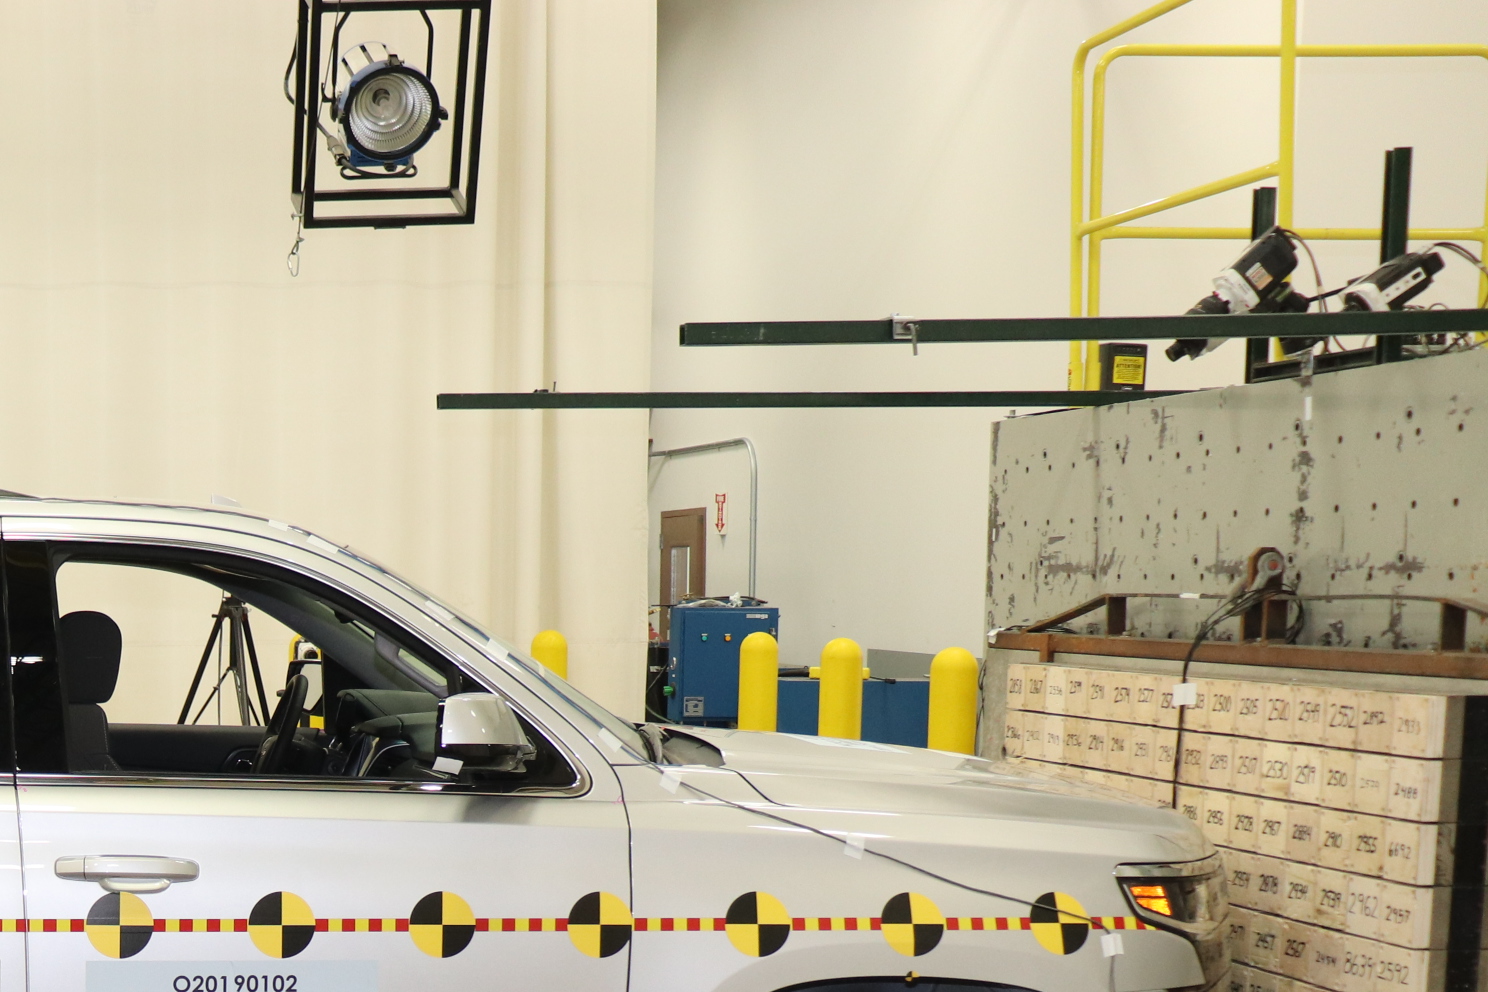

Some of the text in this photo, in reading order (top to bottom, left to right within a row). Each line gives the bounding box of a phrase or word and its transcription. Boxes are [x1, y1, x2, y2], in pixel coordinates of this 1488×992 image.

[1349, 891, 1379, 920] 2962
[1345, 950, 1372, 980] 8639
[1377, 959, 1409, 985] 2592
